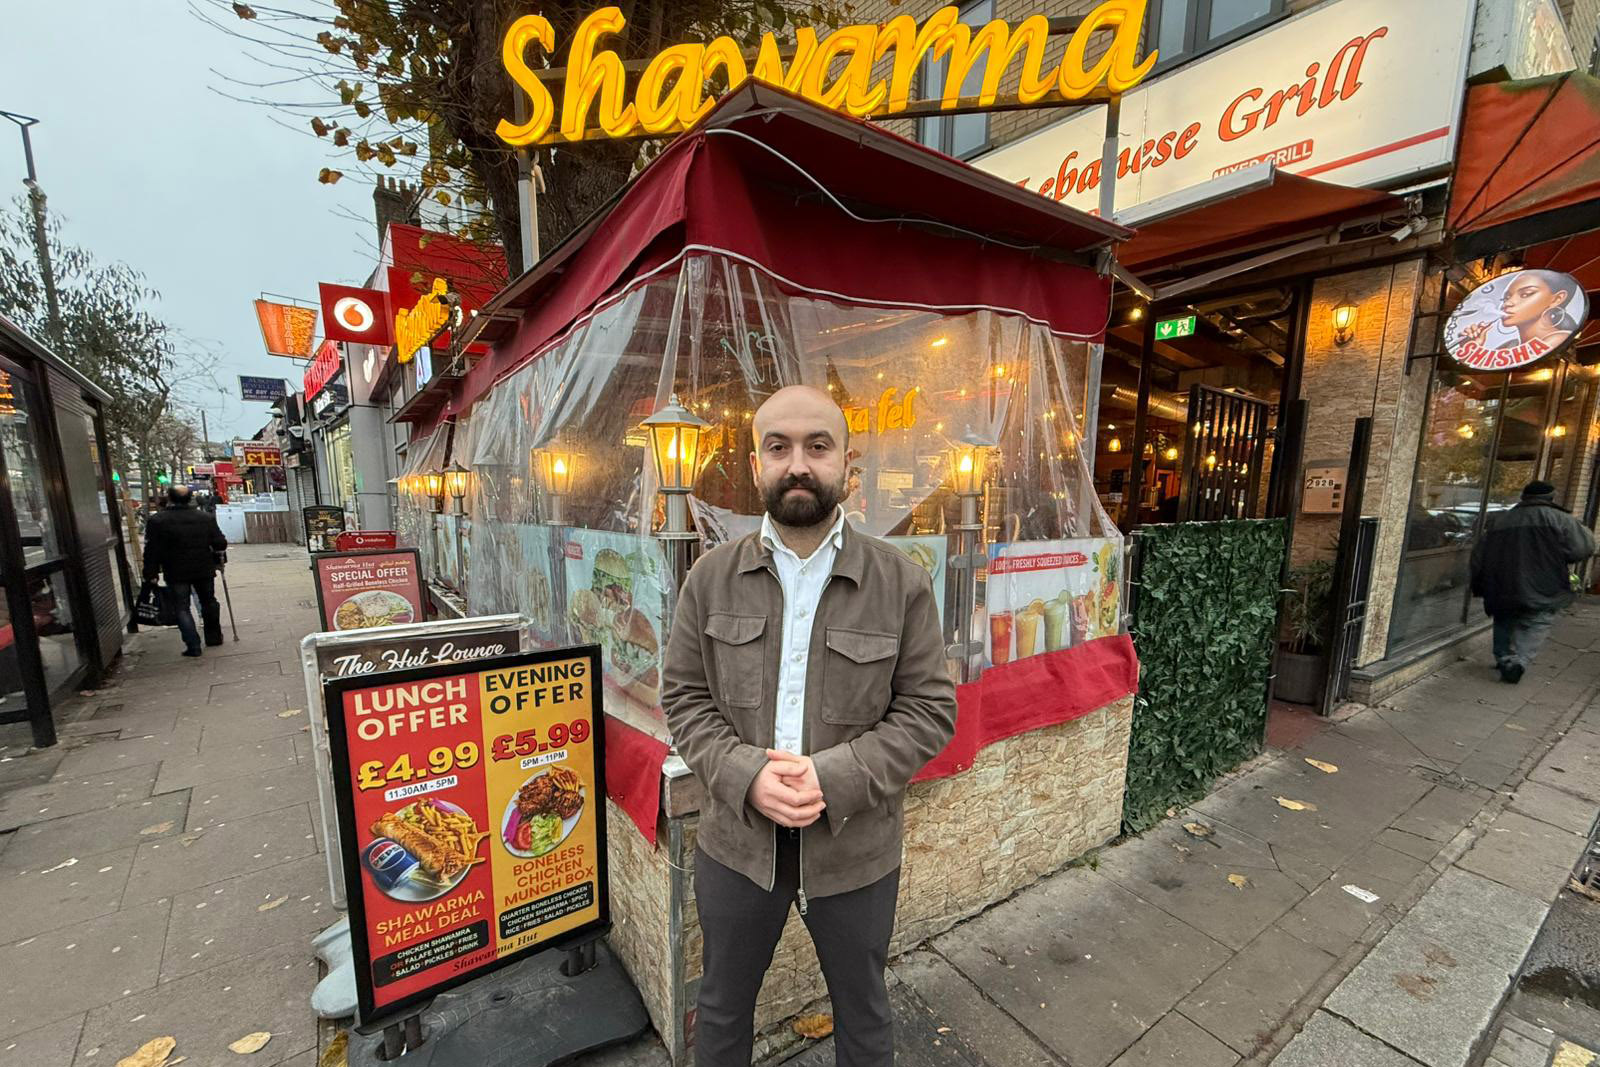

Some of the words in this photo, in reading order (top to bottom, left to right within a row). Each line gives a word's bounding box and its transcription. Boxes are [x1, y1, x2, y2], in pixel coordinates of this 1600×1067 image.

[496, 0, 1159, 146] Shawarma
[1016, 122, 1201, 201] ebanese
[1218, 26, 1388, 142] Grill
[1456, 337, 1551, 368] SHISHA
[331, 570, 374, 582] SPECIAL
[377, 567, 408, 578] OFFER
[1012, 558, 1036, 569] FRESHLY
[1036, 556, 1062, 567] SQUEEZED
[333, 654, 377, 677] The
[381, 647, 430, 670] Hut
[485, 661, 586, 692] EVENING
[354, 678, 467, 716] LUNCH
[489, 682, 584, 714] OFFER
[357, 703, 468, 741] OFFER
[491, 719, 591, 763] £5.99
[357, 741, 480, 791] £4.99
[522, 756, 537, 768] 5PM
[546, 751, 565, 764] 11PM
[388, 783, 427, 800] 11.30AM
[435, 776, 456, 788] 5PM
[513, 844, 585, 876] BONELESS
[517, 857, 582, 888] CHICKEN
[500, 905, 530, 921] QUARTER
[531, 894, 562, 911] BONELESS
[563, 885, 588, 899] CHICKEN
[504, 878, 561, 906] MUNCH
[566, 865, 594, 884] BOX
[376, 889, 485, 935] SHAWARMA
[384, 922, 433, 948] MEAL
[438, 905, 480, 929] DEAL
[505, 926, 520, 936] RICE
[523, 918, 541, 929] FRIES
[544, 909, 564, 920] SALAD
[566, 899, 590, 912] PICKLES
[507, 913, 534, 927] CHICKEN
[535, 900, 568, 916] SHAWARMA
[571, 893, 588, 903] SPICY
[390, 960, 404, 970] OR
[405, 948, 433, 965] FALAFE
[433, 941, 455, 953] WRAP
[458, 932, 478, 944] FRIES
[395, 963, 421, 977] SALAD
[424, 951, 454, 967] PICKLES
[457, 940, 479, 953] DRINK
[397, 941, 430, 959] CHICKEN
[453, 941, 513, 972] Shawarma
[517, 932, 538, 948] Hut
